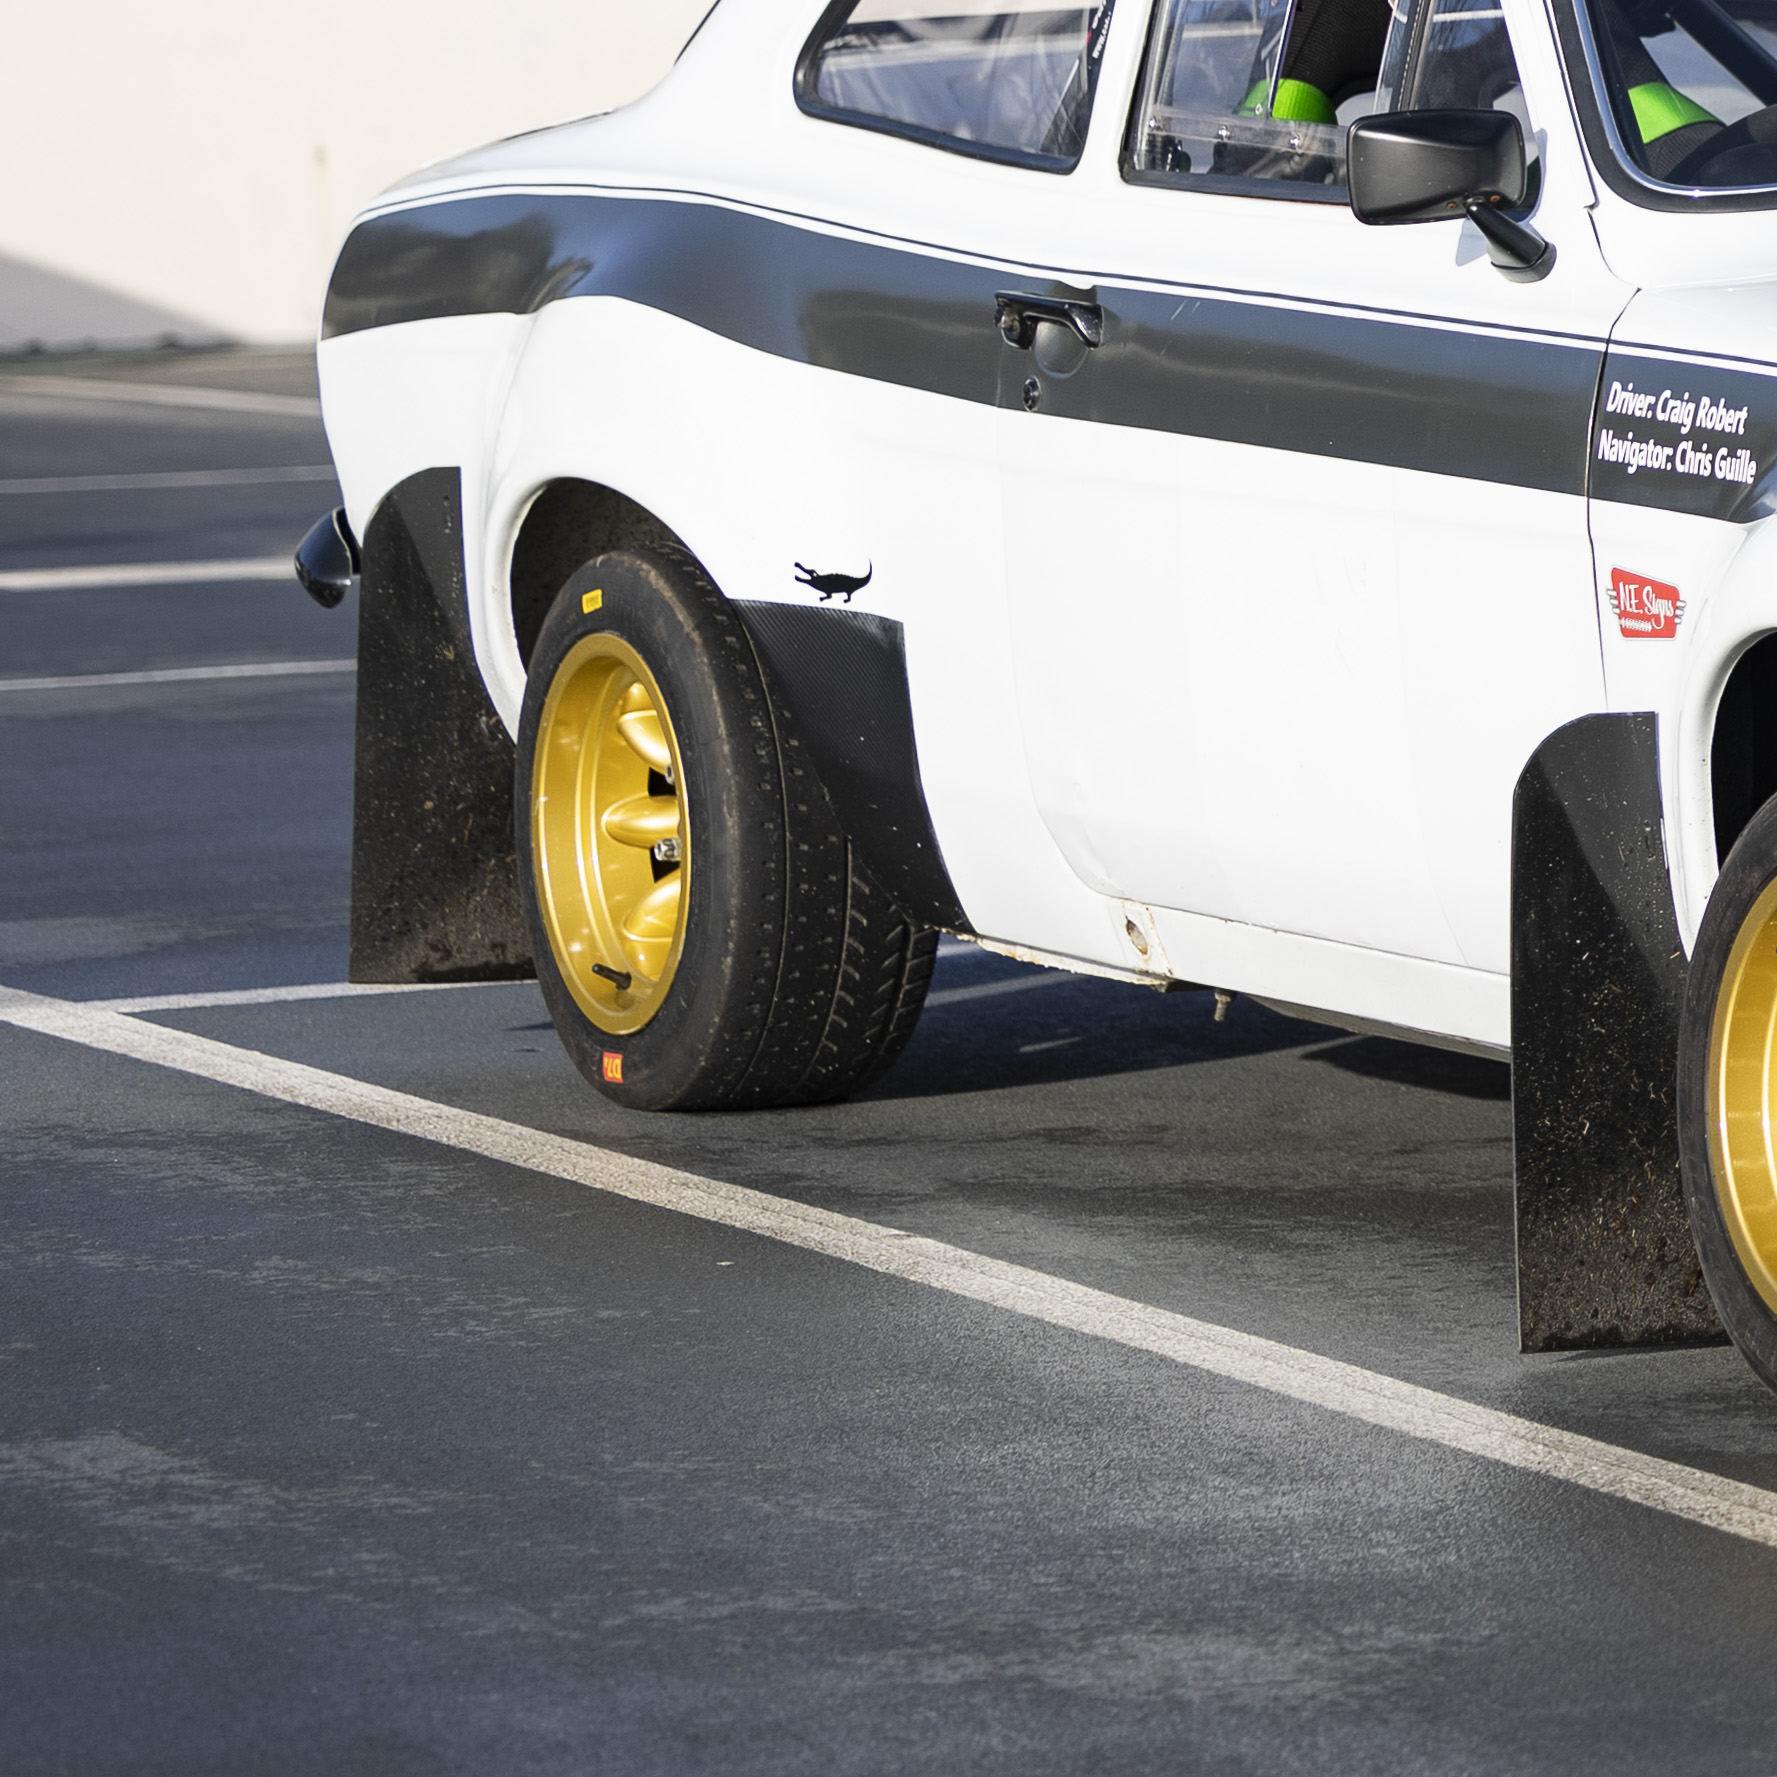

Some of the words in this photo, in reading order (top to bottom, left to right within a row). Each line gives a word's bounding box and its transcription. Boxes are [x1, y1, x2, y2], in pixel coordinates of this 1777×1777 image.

[1606, 381, 1656, 419] Driver:
[1656, 389, 1696, 434] Craig
[1695, 396, 1748, 435] Robert
[1598, 429, 1674, 474] Navigator:
[1675, 440, 1713, 477] Chris
[1715, 447, 1757, 484] Guille
[1642, 585, 1674, 630] Signs
